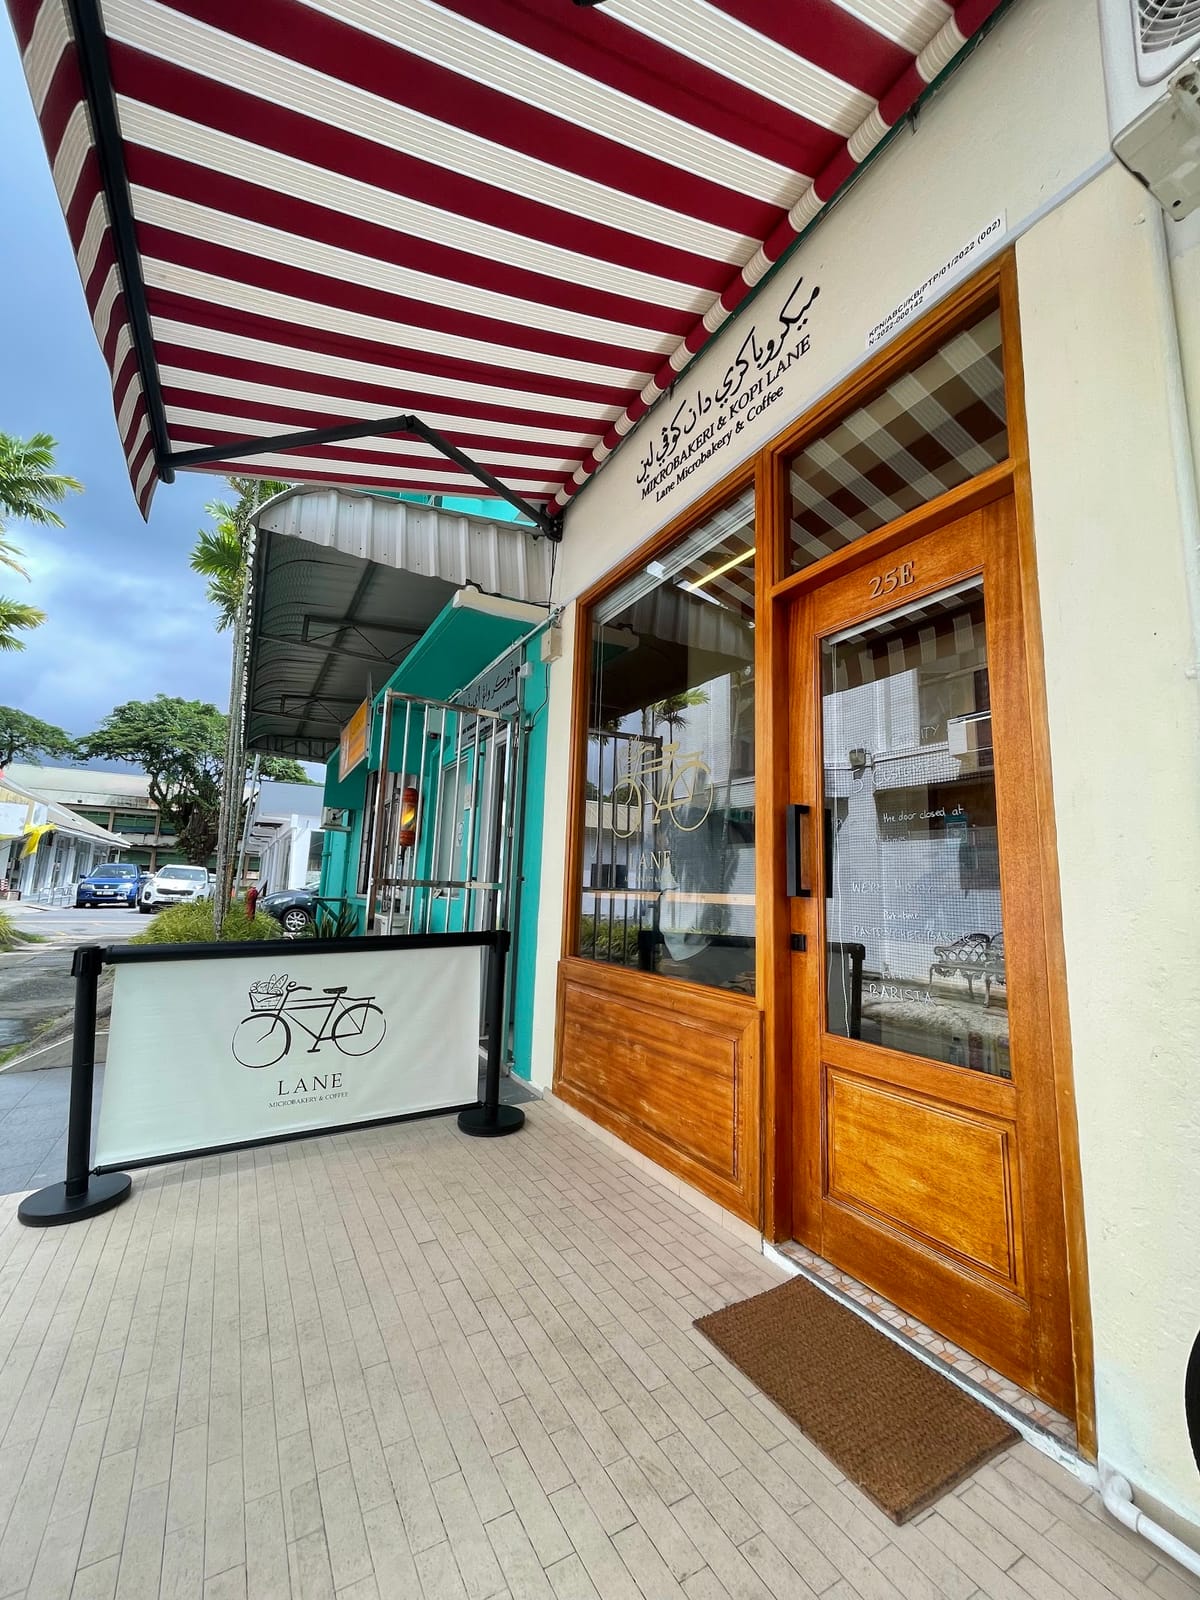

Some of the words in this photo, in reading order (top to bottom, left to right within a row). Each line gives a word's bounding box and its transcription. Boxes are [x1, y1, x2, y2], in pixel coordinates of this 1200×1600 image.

[977, 218, 1001, 244] (002)
[641, 422, 715, 500] MIKROBAKERI
[717, 415, 727, 431] &
[729, 378, 763, 420] KOPI
[766, 334, 811, 387] LANE
[683, 390, 712, 434] دان
[656, 481, 675, 503] Lane
[676, 432, 734, 486] Microbakery
[735, 420, 745, 434] &
[747, 386, 784, 421] Coffee
[868, 560, 915, 600] 25E
[882, 812, 896, 824] the
[898, 810, 917, 821] door
[919, 807, 946, 821] closed
[951, 803, 965, 817] at
[868, 983, 936, 1007] BARISTA
[278, 1073, 343, 1096] LANE
[268, 1096, 317, 1109] MICROBAKERY
[325, 1092, 348, 1101] COFFEE
